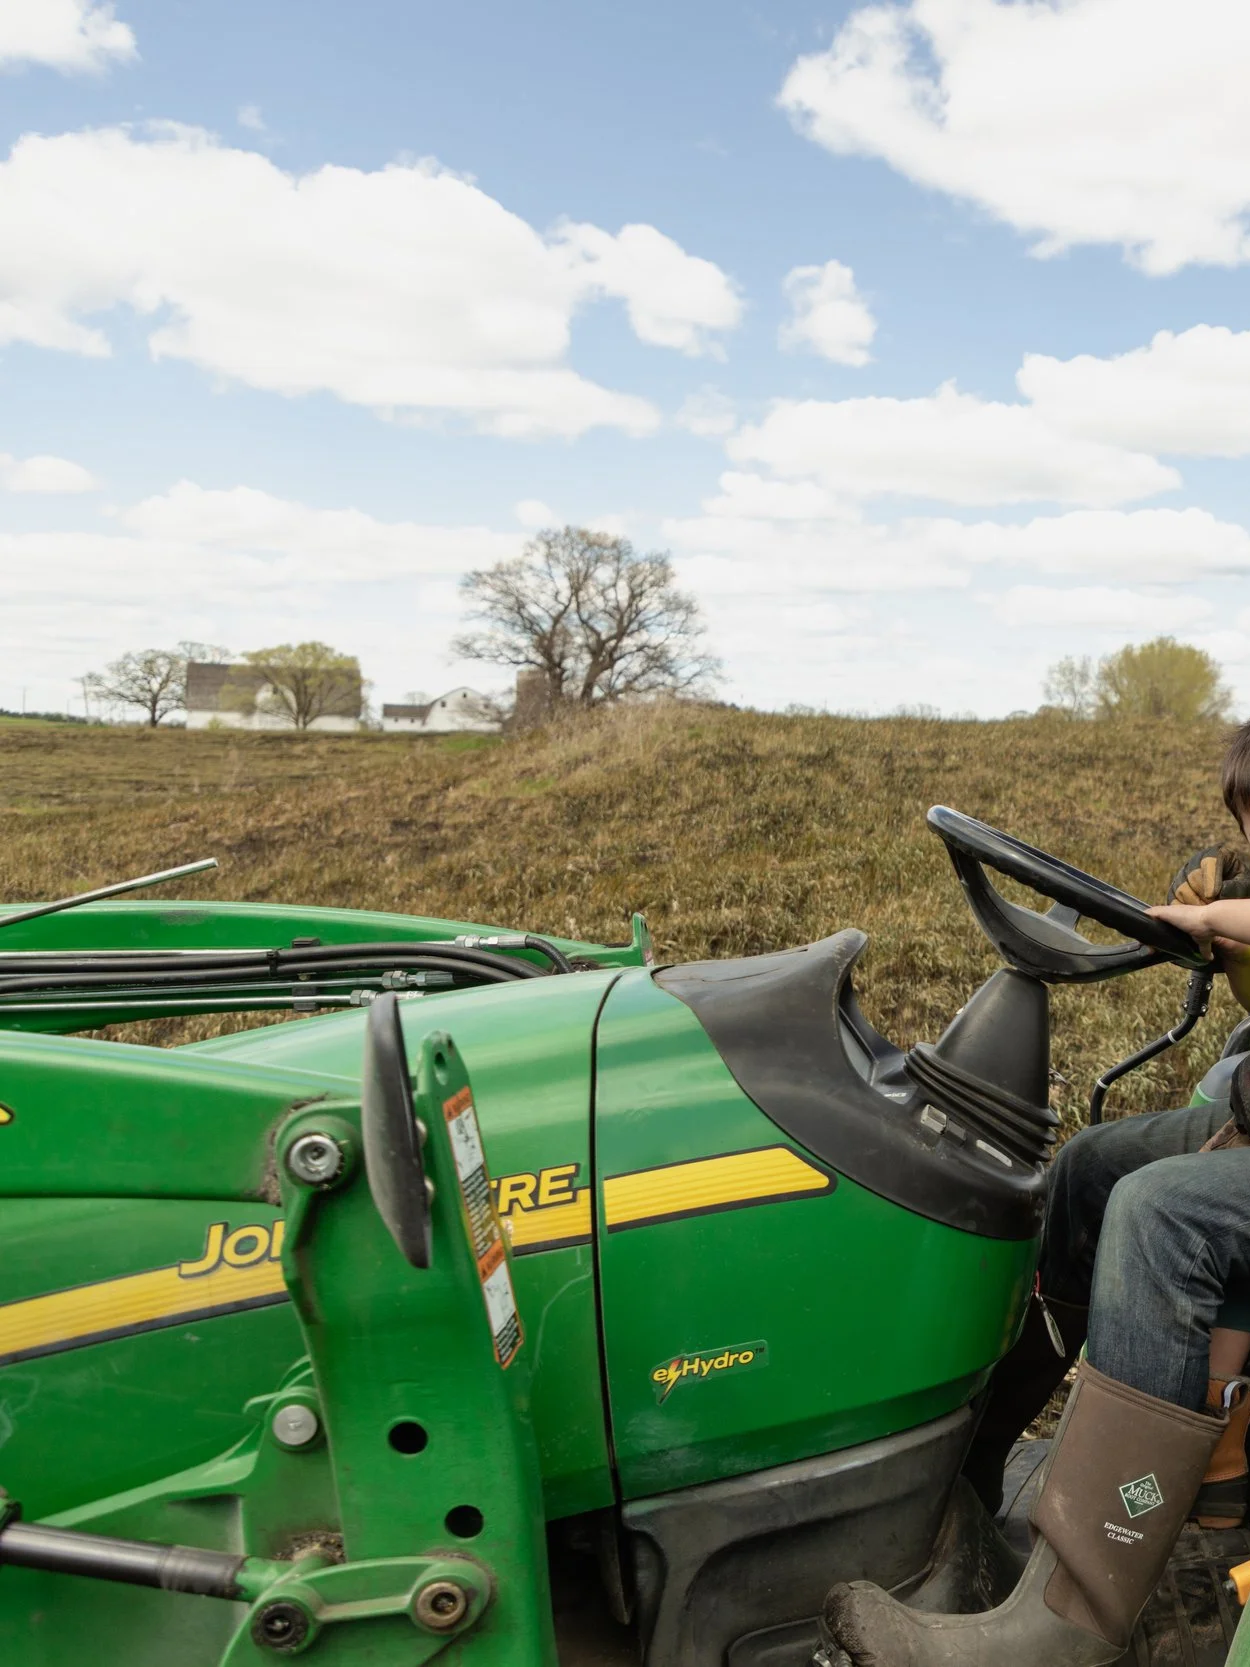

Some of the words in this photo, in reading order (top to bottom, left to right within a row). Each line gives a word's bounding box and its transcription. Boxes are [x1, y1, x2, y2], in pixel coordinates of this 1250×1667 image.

[490, 1163, 579, 1215] RE
[1128, 1484, 1159, 1503] MUCK
[1104, 1522, 1144, 1540] EDGEWATER
[1107, 1531, 1135, 1545] CLASSIC
